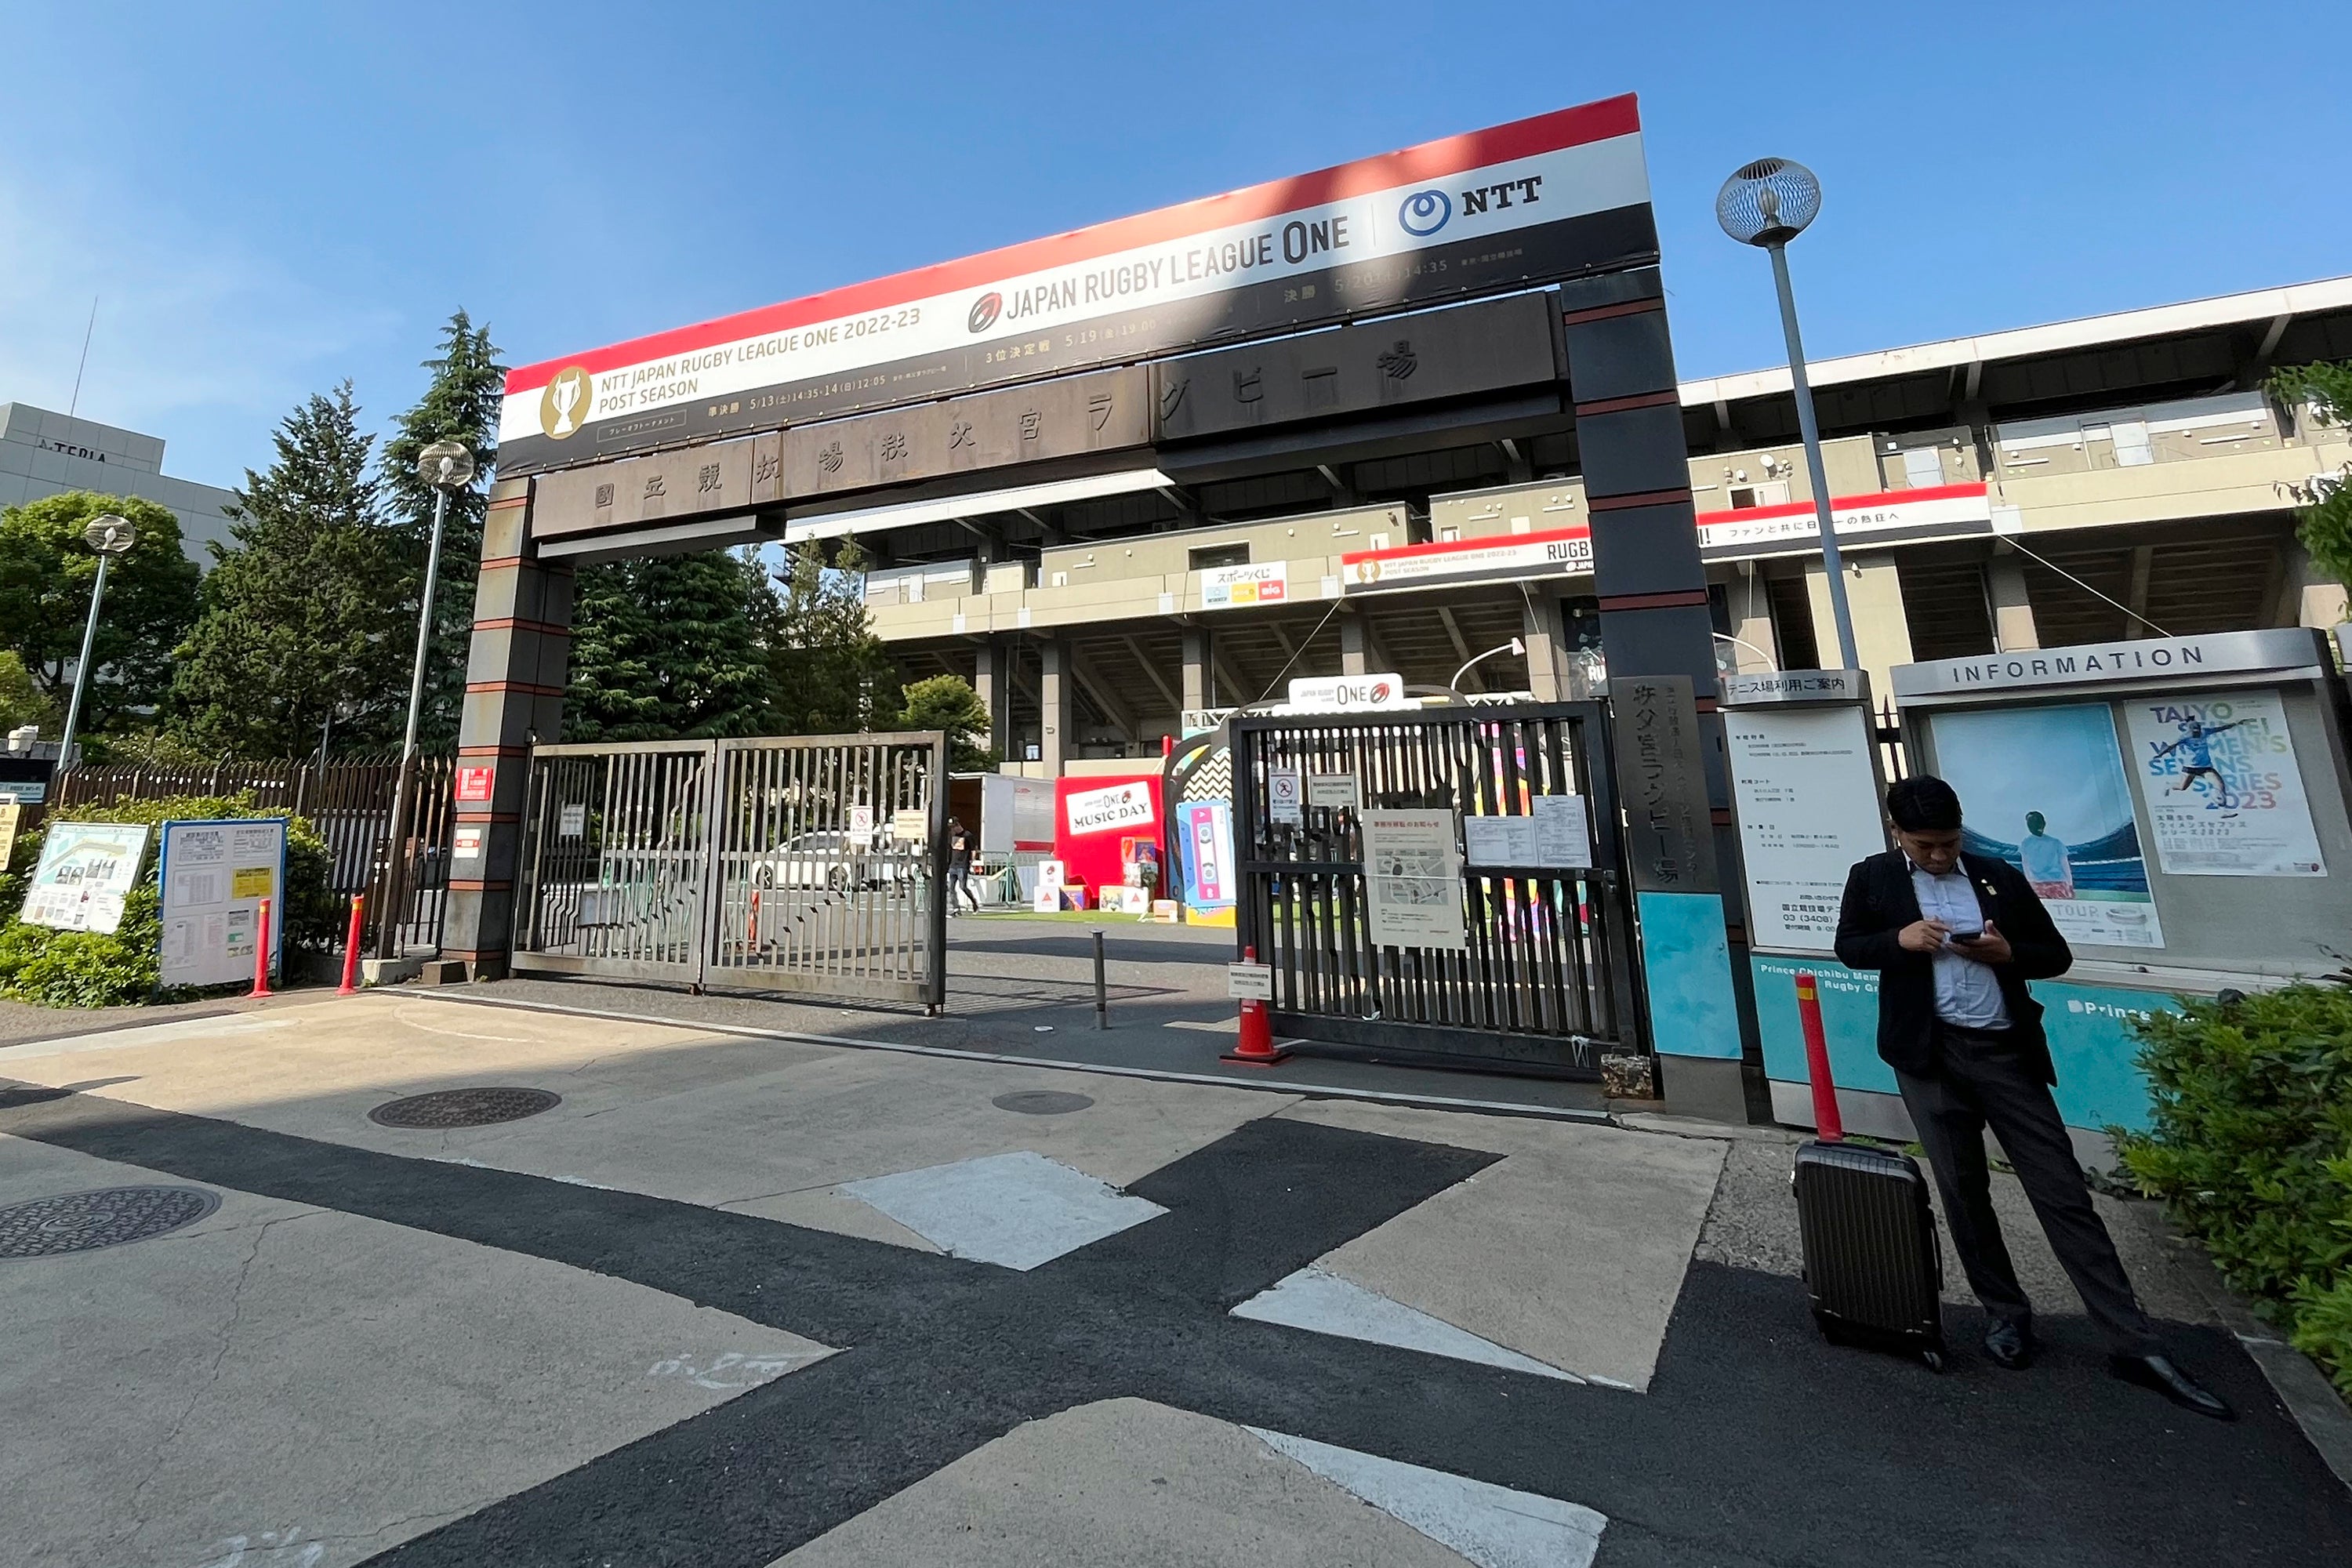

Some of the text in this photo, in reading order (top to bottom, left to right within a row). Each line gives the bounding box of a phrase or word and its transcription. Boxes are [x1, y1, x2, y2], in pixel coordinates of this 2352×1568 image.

[1462, 176, 1541, 216] NTT
[1007, 215, 1349, 320] JAPAN RUGBY LEAGUE ONE
[1283, 285, 1316, 303] 決勝
[601, 308, 920, 393] NTT JAPAN RUGBY LEAGUE ONE 2022-23
[599, 378, 699, 413] POST SEASON
[1730, 512, 1899, 537] ファンと共に日一の熱狂へ
[1548, 540, 1592, 561] RUGB
[1953, 645, 2203, 684] INFORMATION
[1337, 684, 1367, 706] ONE
[1727, 677, 1845, 696] テニス場利用ご案内
[2150, 702, 2233, 724] TAIYO
[2149, 735, 2288, 757] WMEN'S
[2192, 772, 2282, 792] SRIES
[1075, 811, 1116, 828] MUSIC
[1120, 802, 1149, 818] DAY
[1760, 964, 1796, 975] Prince
[1798, 967, 1849, 980] Chichibu
[1824, 980, 1860, 993] Rugby
